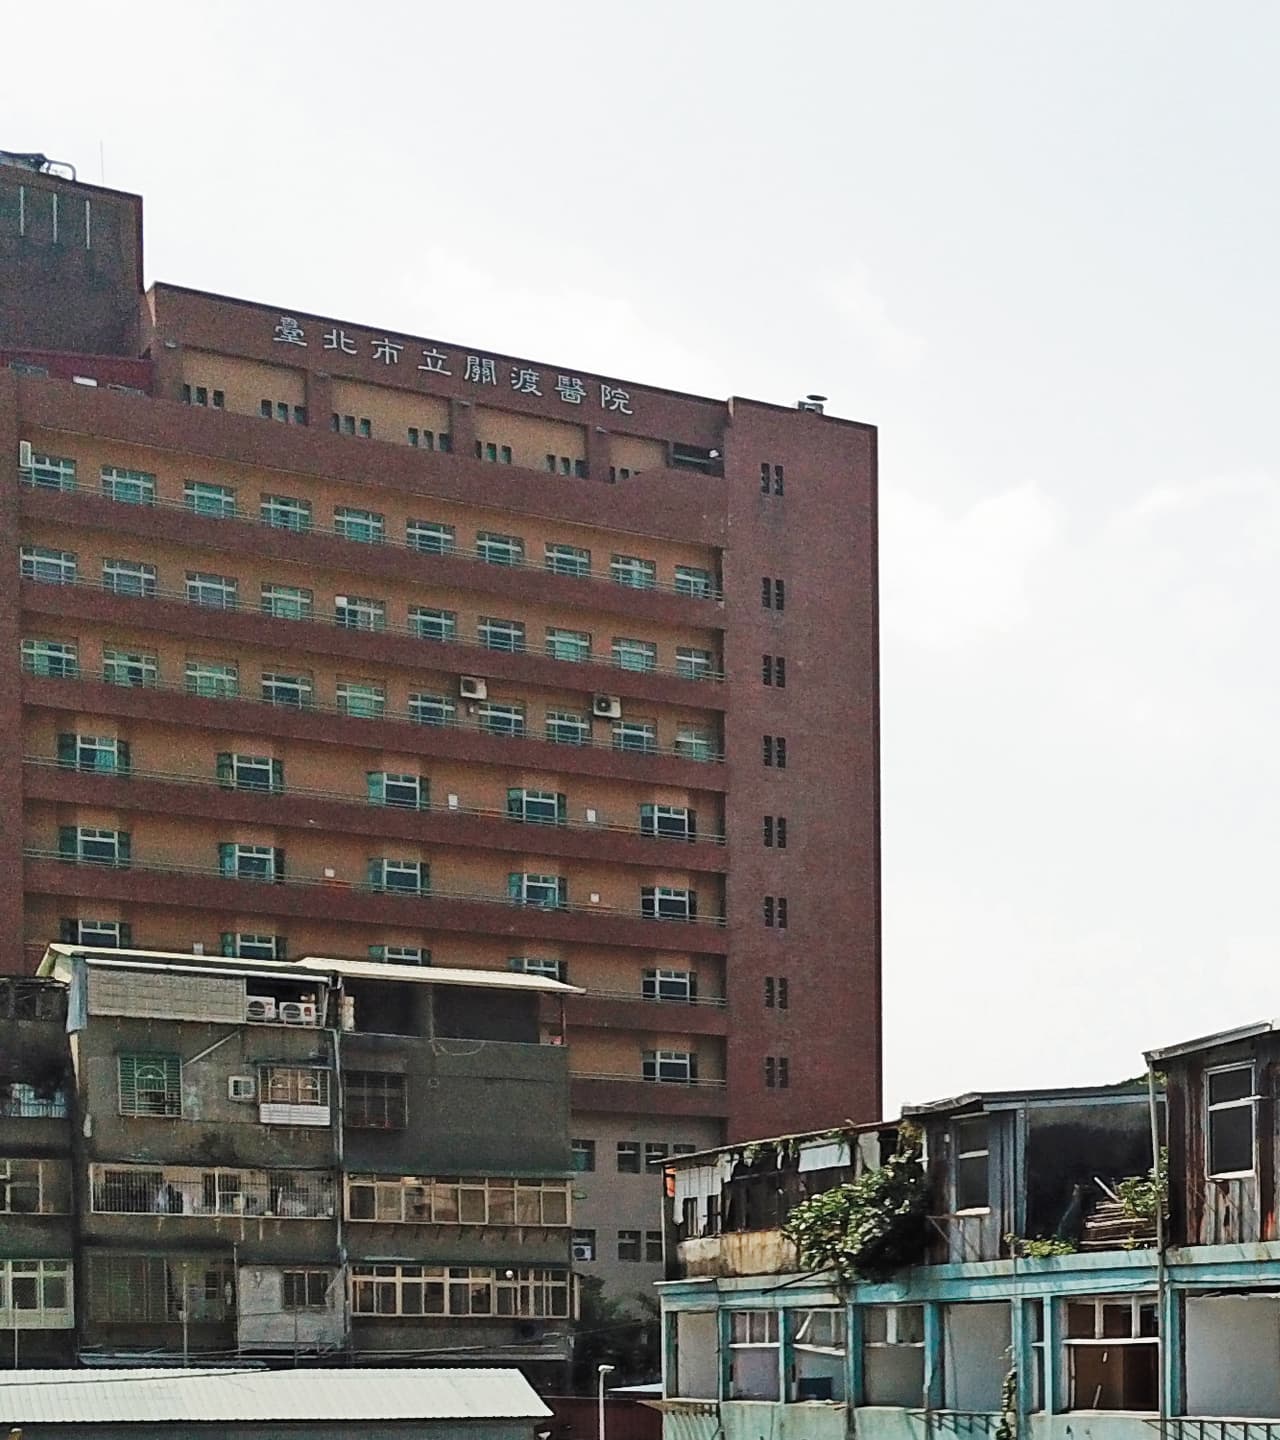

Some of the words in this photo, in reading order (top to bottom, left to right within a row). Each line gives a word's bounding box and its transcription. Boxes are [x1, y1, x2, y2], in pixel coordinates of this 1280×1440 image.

[273, 316, 634, 415] 臺北市立關渡醫院
